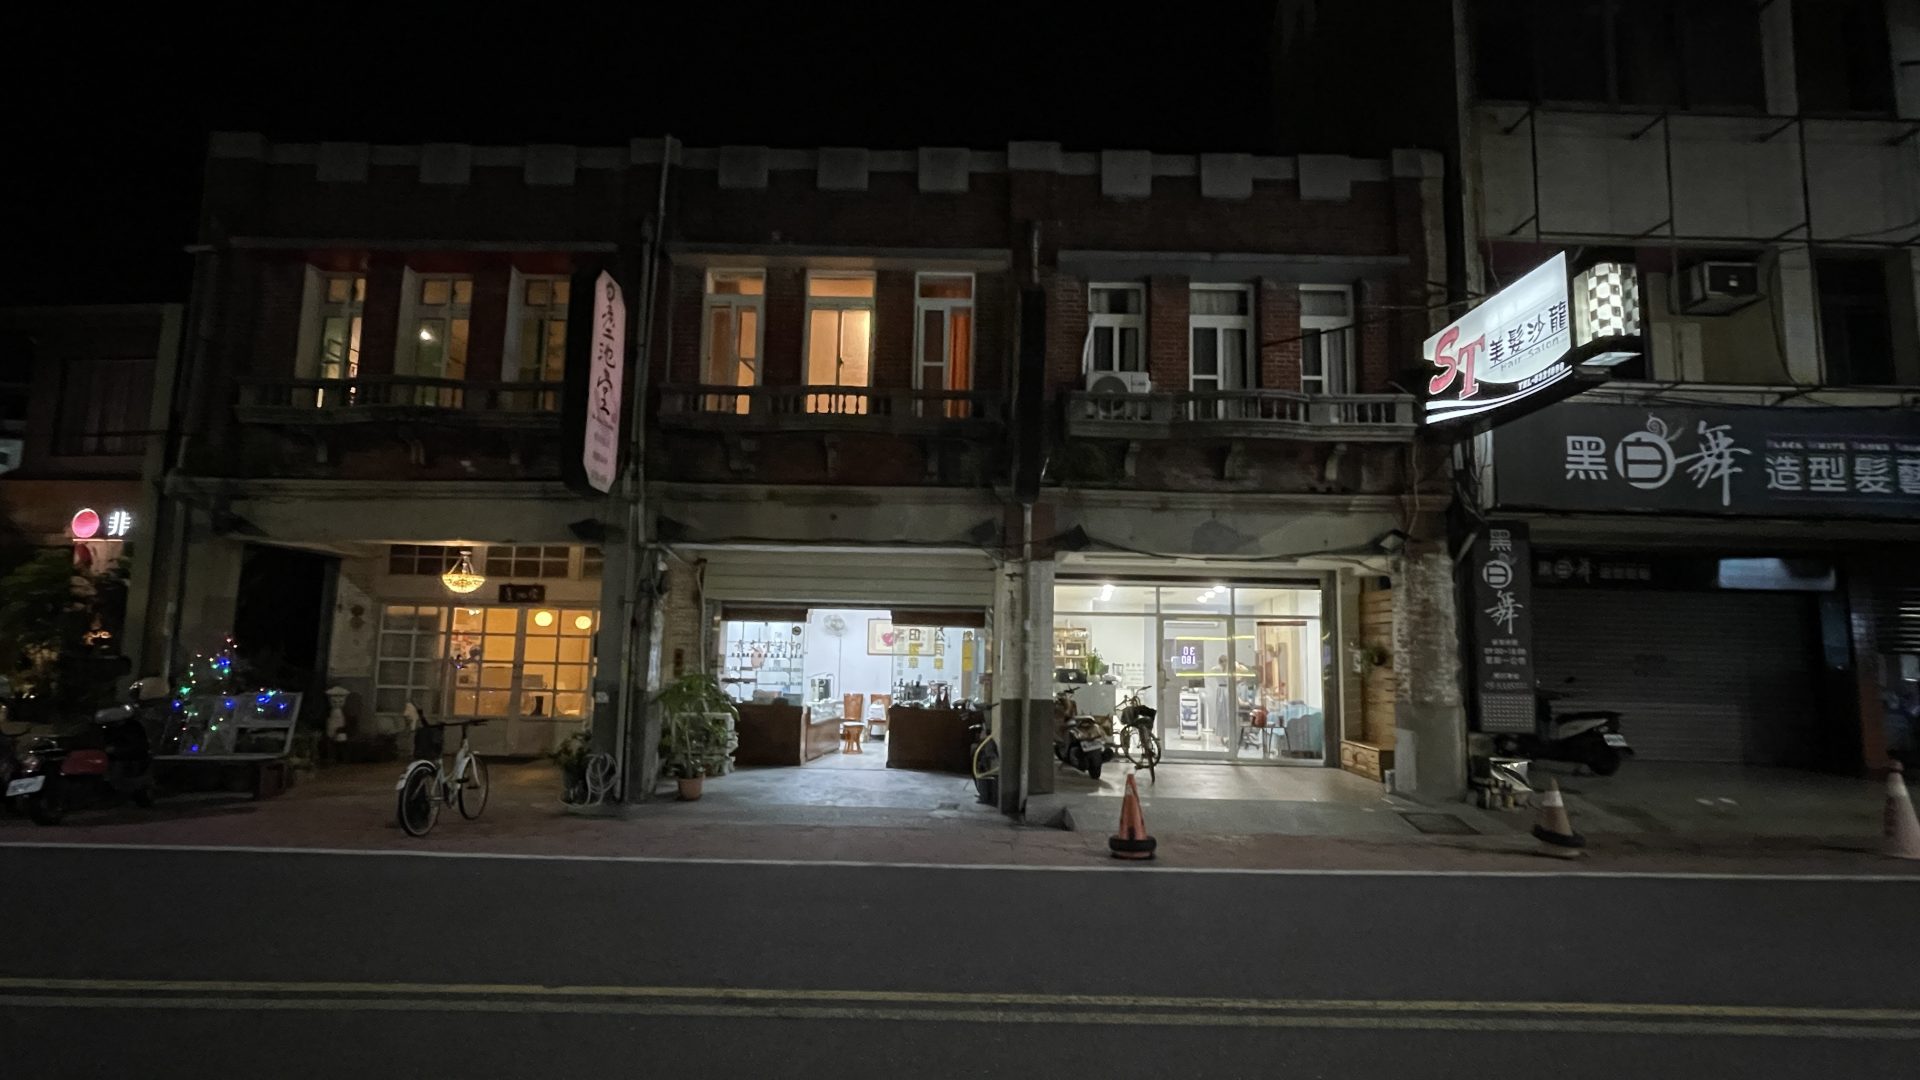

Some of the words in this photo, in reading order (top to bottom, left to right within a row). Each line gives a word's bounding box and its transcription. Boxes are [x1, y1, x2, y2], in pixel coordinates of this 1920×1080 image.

[1428, 325, 1487, 401] ST
[1489, 300, 1567, 364] 美髮沙龍
[1528, 337, 1559, 358] Salon
